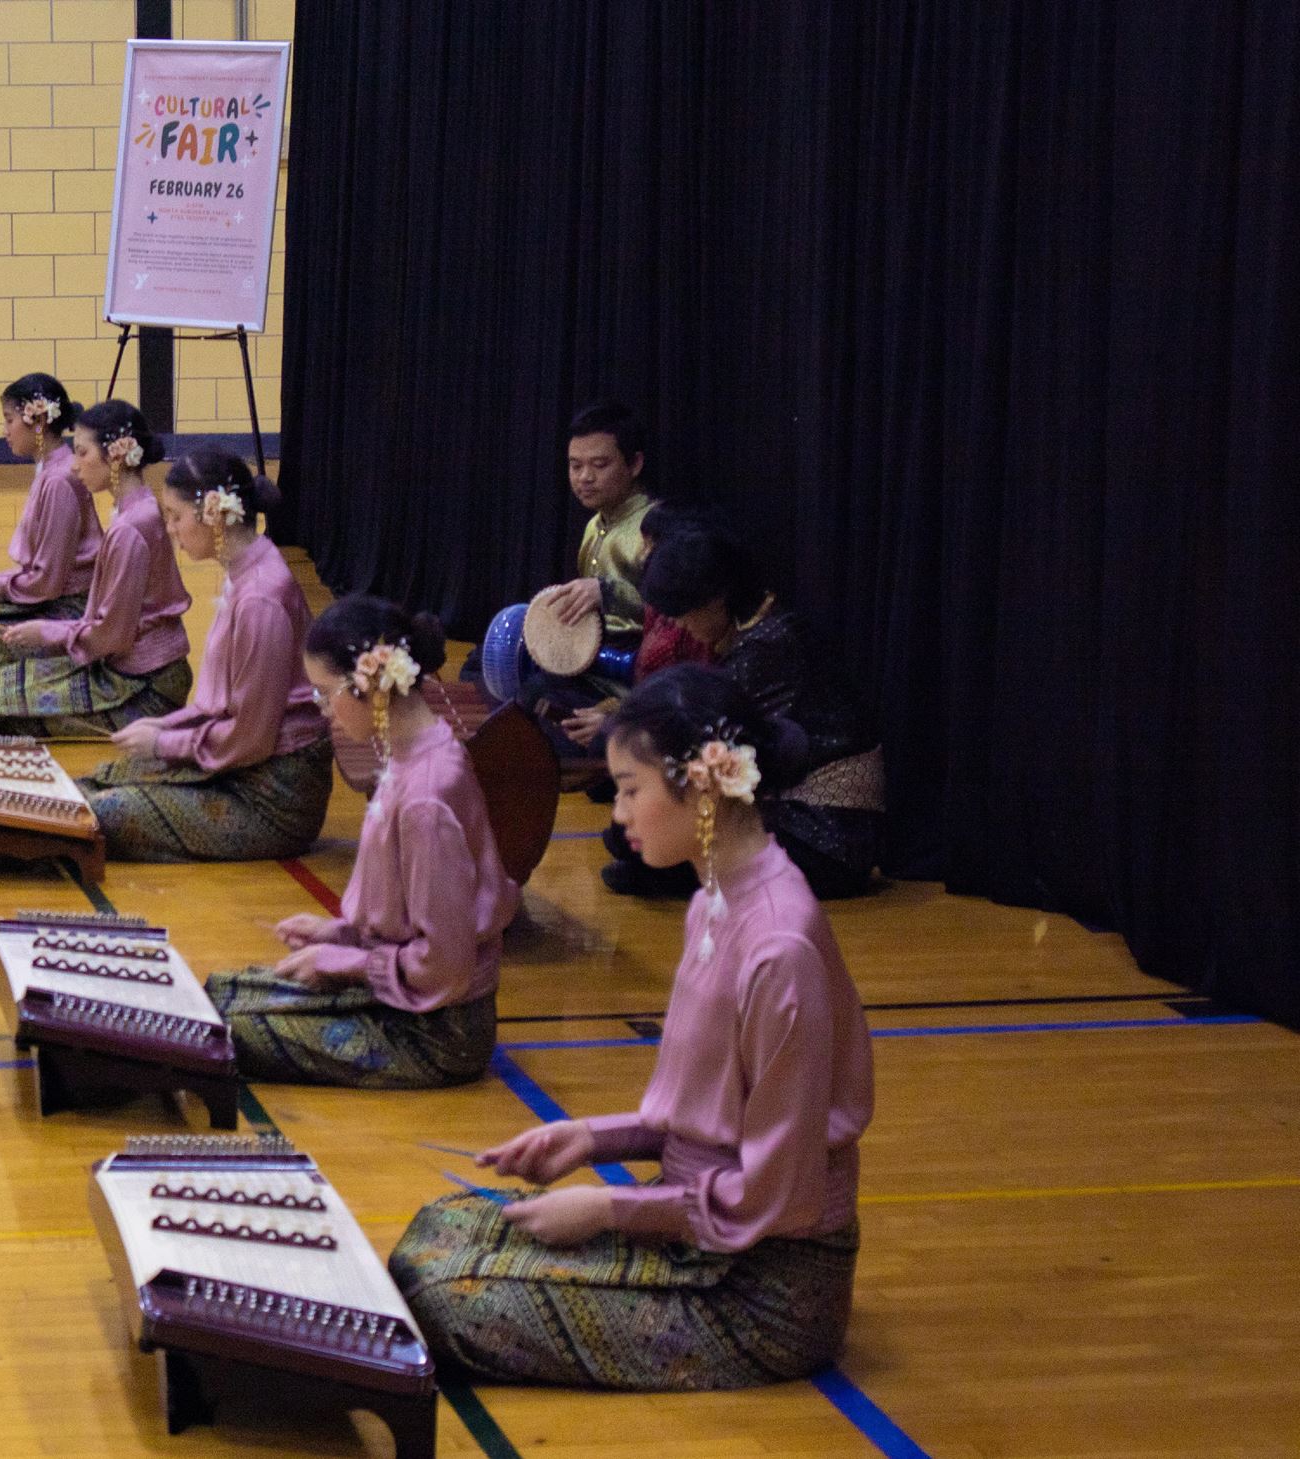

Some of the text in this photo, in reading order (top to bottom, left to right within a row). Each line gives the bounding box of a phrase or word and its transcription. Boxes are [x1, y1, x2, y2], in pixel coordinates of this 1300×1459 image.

[154, 94, 250, 119] CULTURAL
[160, 120, 240, 167] FAIR
[149, 178, 244, 199] FEBRUARY 26
